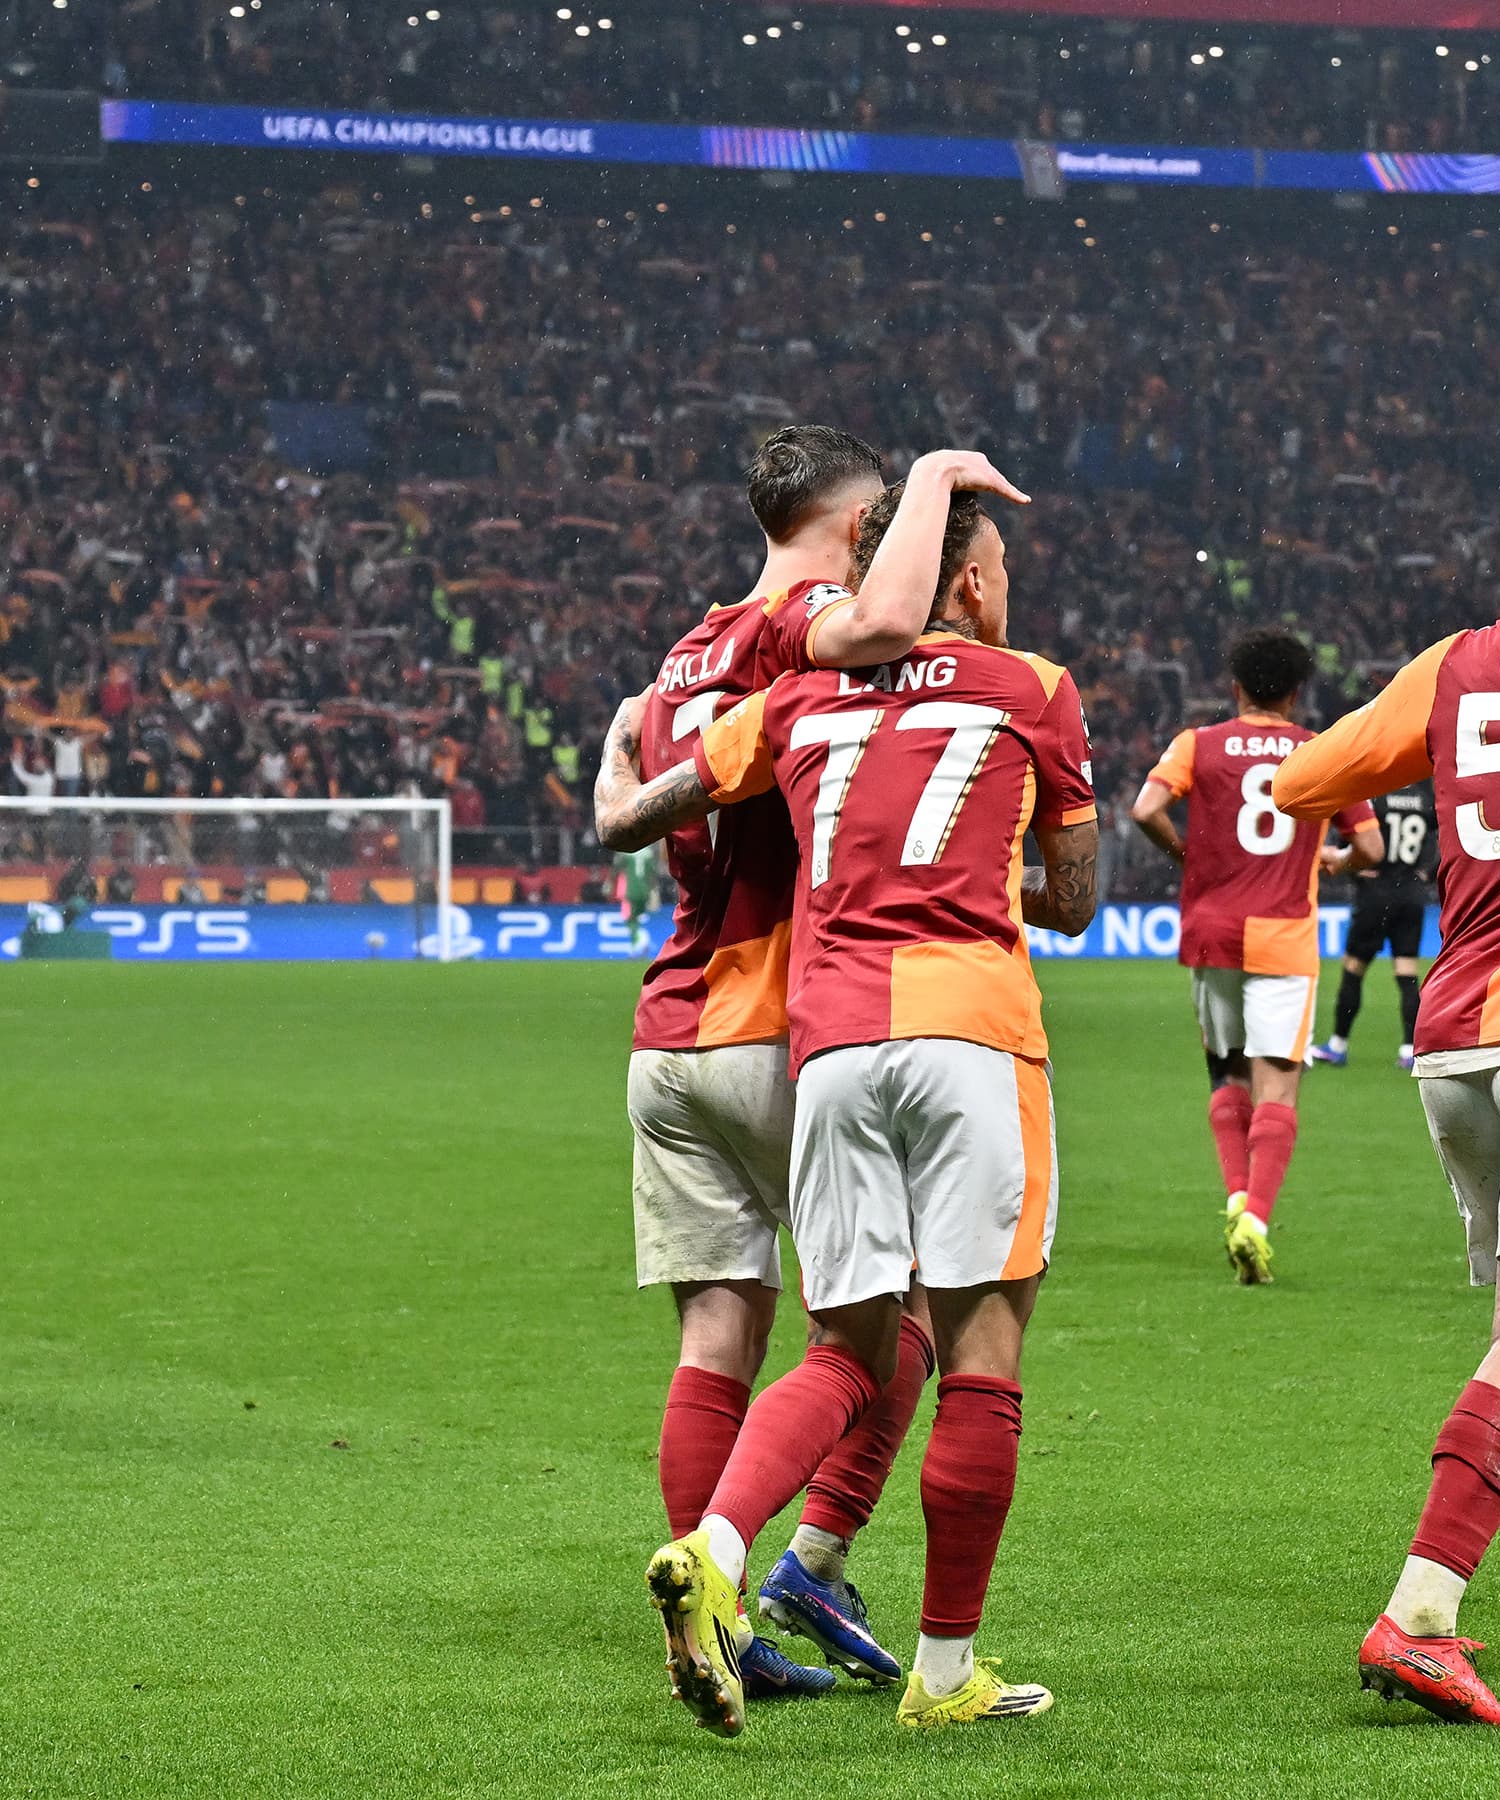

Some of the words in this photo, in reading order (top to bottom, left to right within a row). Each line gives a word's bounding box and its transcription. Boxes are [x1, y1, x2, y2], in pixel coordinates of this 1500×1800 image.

[263, 116, 331, 141] UEFA
[335, 118, 490, 149] CHAMPIONS
[495, 125, 594, 154] LEAGUE
[658, 637, 735, 695] SALLA
[838, 655, 958, 695] LANG
[1225, 736, 1305, 758] G.SAR
[790, 701, 1011, 890] 77
[1237, 763, 1296, 856] 8
[1385, 812, 1427, 865] 18
[91, 910, 253, 953] PS5
[497, 910, 651, 954] PS5
[1102, 905, 1182, 956] NO
